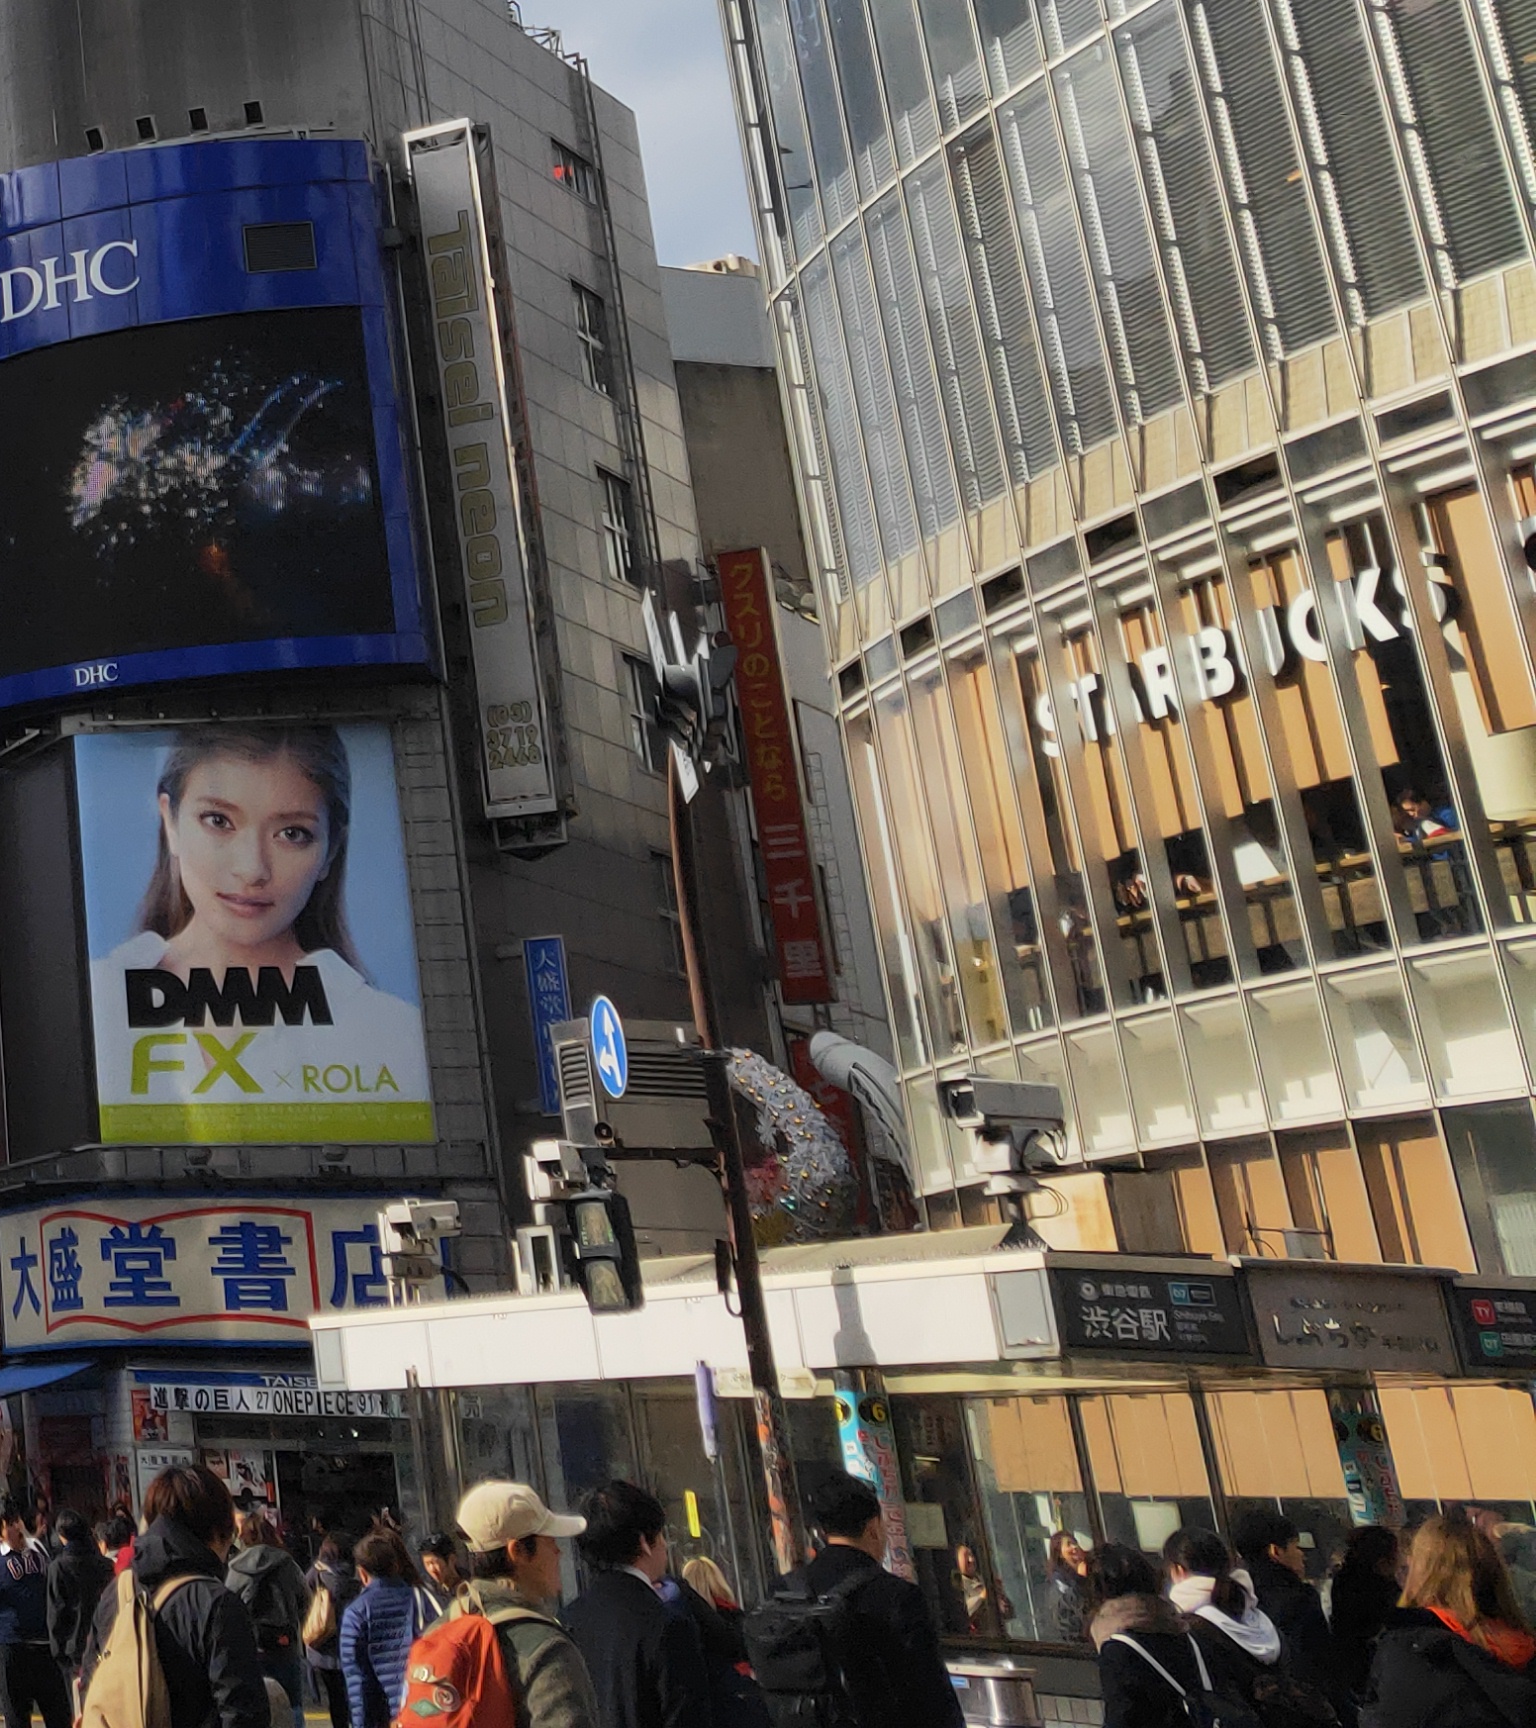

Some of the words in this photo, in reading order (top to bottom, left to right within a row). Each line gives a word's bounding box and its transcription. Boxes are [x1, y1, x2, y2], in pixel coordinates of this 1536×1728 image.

[74, 662, 120, 688] DHC
[487, 700, 534, 729] (03)
[732, 562, 787, 803] クスリのことなら
[762, 823, 825, 978] 三千里
[125, 965, 334, 1028] DMM
[130, 1032, 265, 1095] FX
[302, 1064, 400, 1094] ROLA
[10, 1221, 406, 1323] 大盛堂書店
[1081, 1305, 1171, 1342] 渋谷駅
[154, 1384, 249, 1411] 進撃の巨人
[255, 1391, 270, 1410] 27
[259, 1375, 319, 1388] TAISE
[6, 1550, 47, 1581] GA
